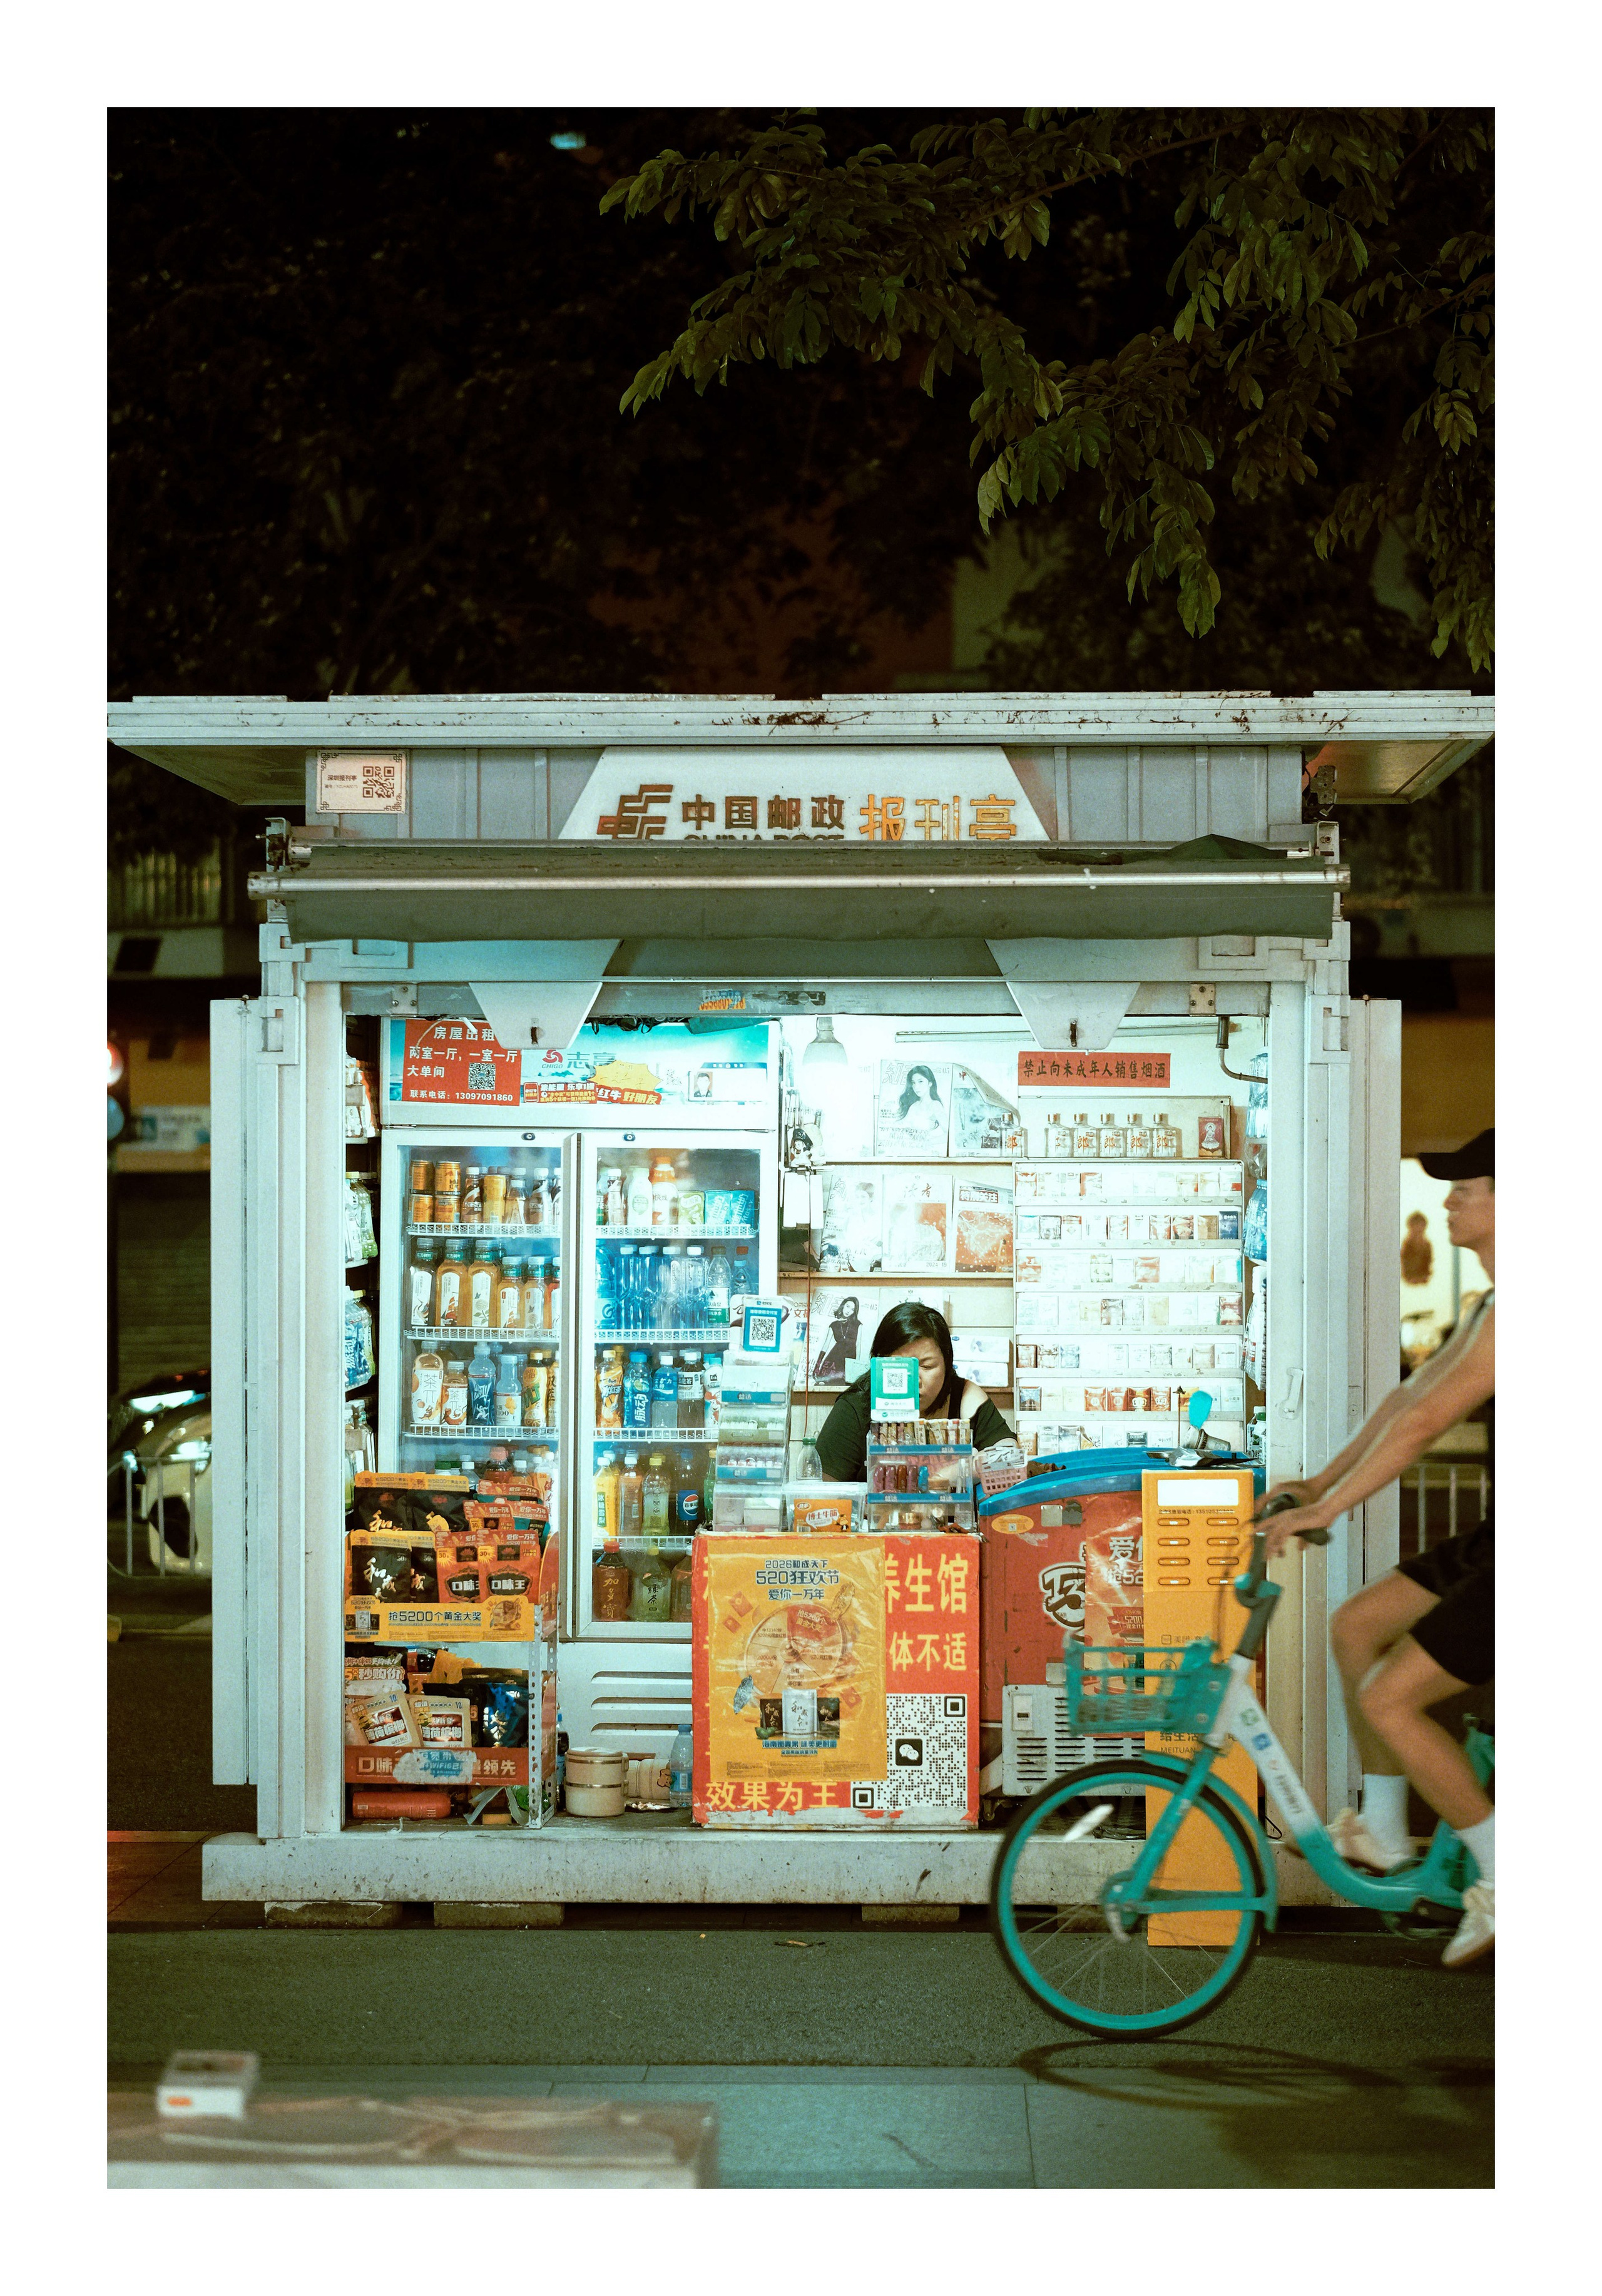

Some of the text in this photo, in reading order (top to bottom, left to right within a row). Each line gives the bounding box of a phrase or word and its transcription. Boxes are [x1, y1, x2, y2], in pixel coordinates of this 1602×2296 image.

[681, 794, 1016, 840] 中国邮政 报刊亭
[434, 1026, 495, 1041] 房屋出租
[407, 1064, 444, 1078] 大单间
[1024, 1059, 1165, 1079] 禁止向未成年人销售烟酒
[623, 1091, 659, 1105] 好朋友
[635, 1393, 649, 1422] 脉动
[491, 1578, 526, 1590] 口味王
[756, 1569, 840, 1586] 520狂欢节
[648, 1584, 658, 1605] 绿茶
[768, 1588, 825, 1601] 爱你一万年
[389, 1610, 482, 1621] 抢5200个黄金大奖
[889, 1631, 967, 1672] 体不适
[357, 1757, 397, 1776] 口味
[706, 1782, 840, 1810] 效果为王
